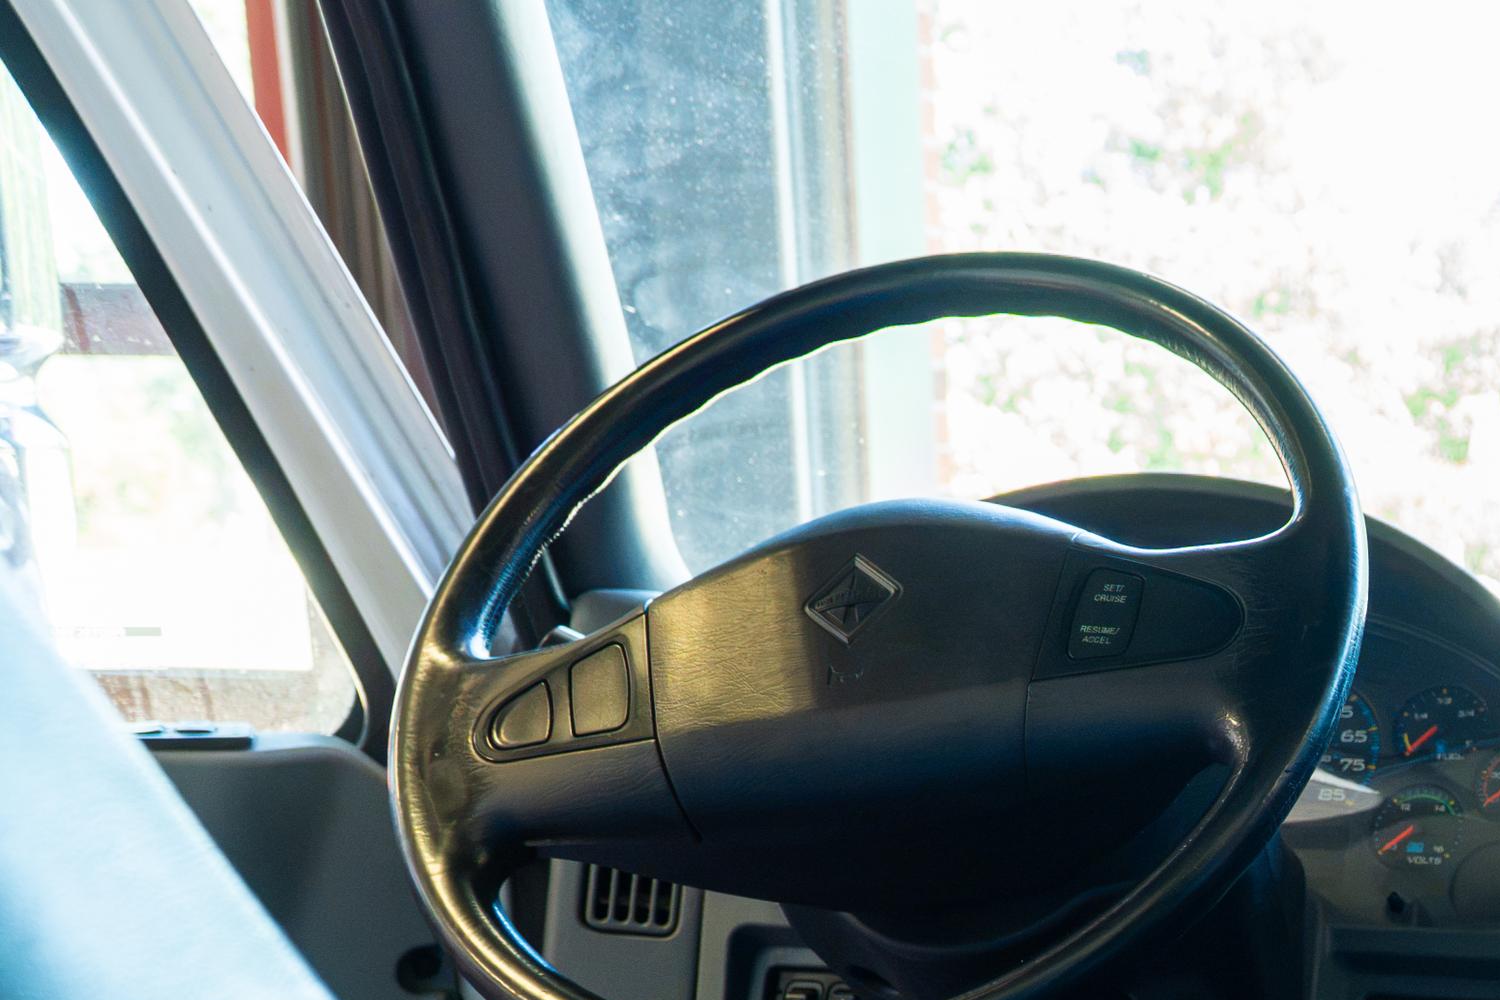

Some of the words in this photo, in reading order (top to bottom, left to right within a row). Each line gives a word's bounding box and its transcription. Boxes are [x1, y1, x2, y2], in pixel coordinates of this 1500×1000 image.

[1094, 594, 1128, 603] CRUISE
[1081, 636, 1112, 645] ACCEL
[1339, 729, 1368, 743] 65
[1340, 757, 1366, 771] 75
[1318, 788, 1345, 801] 85
